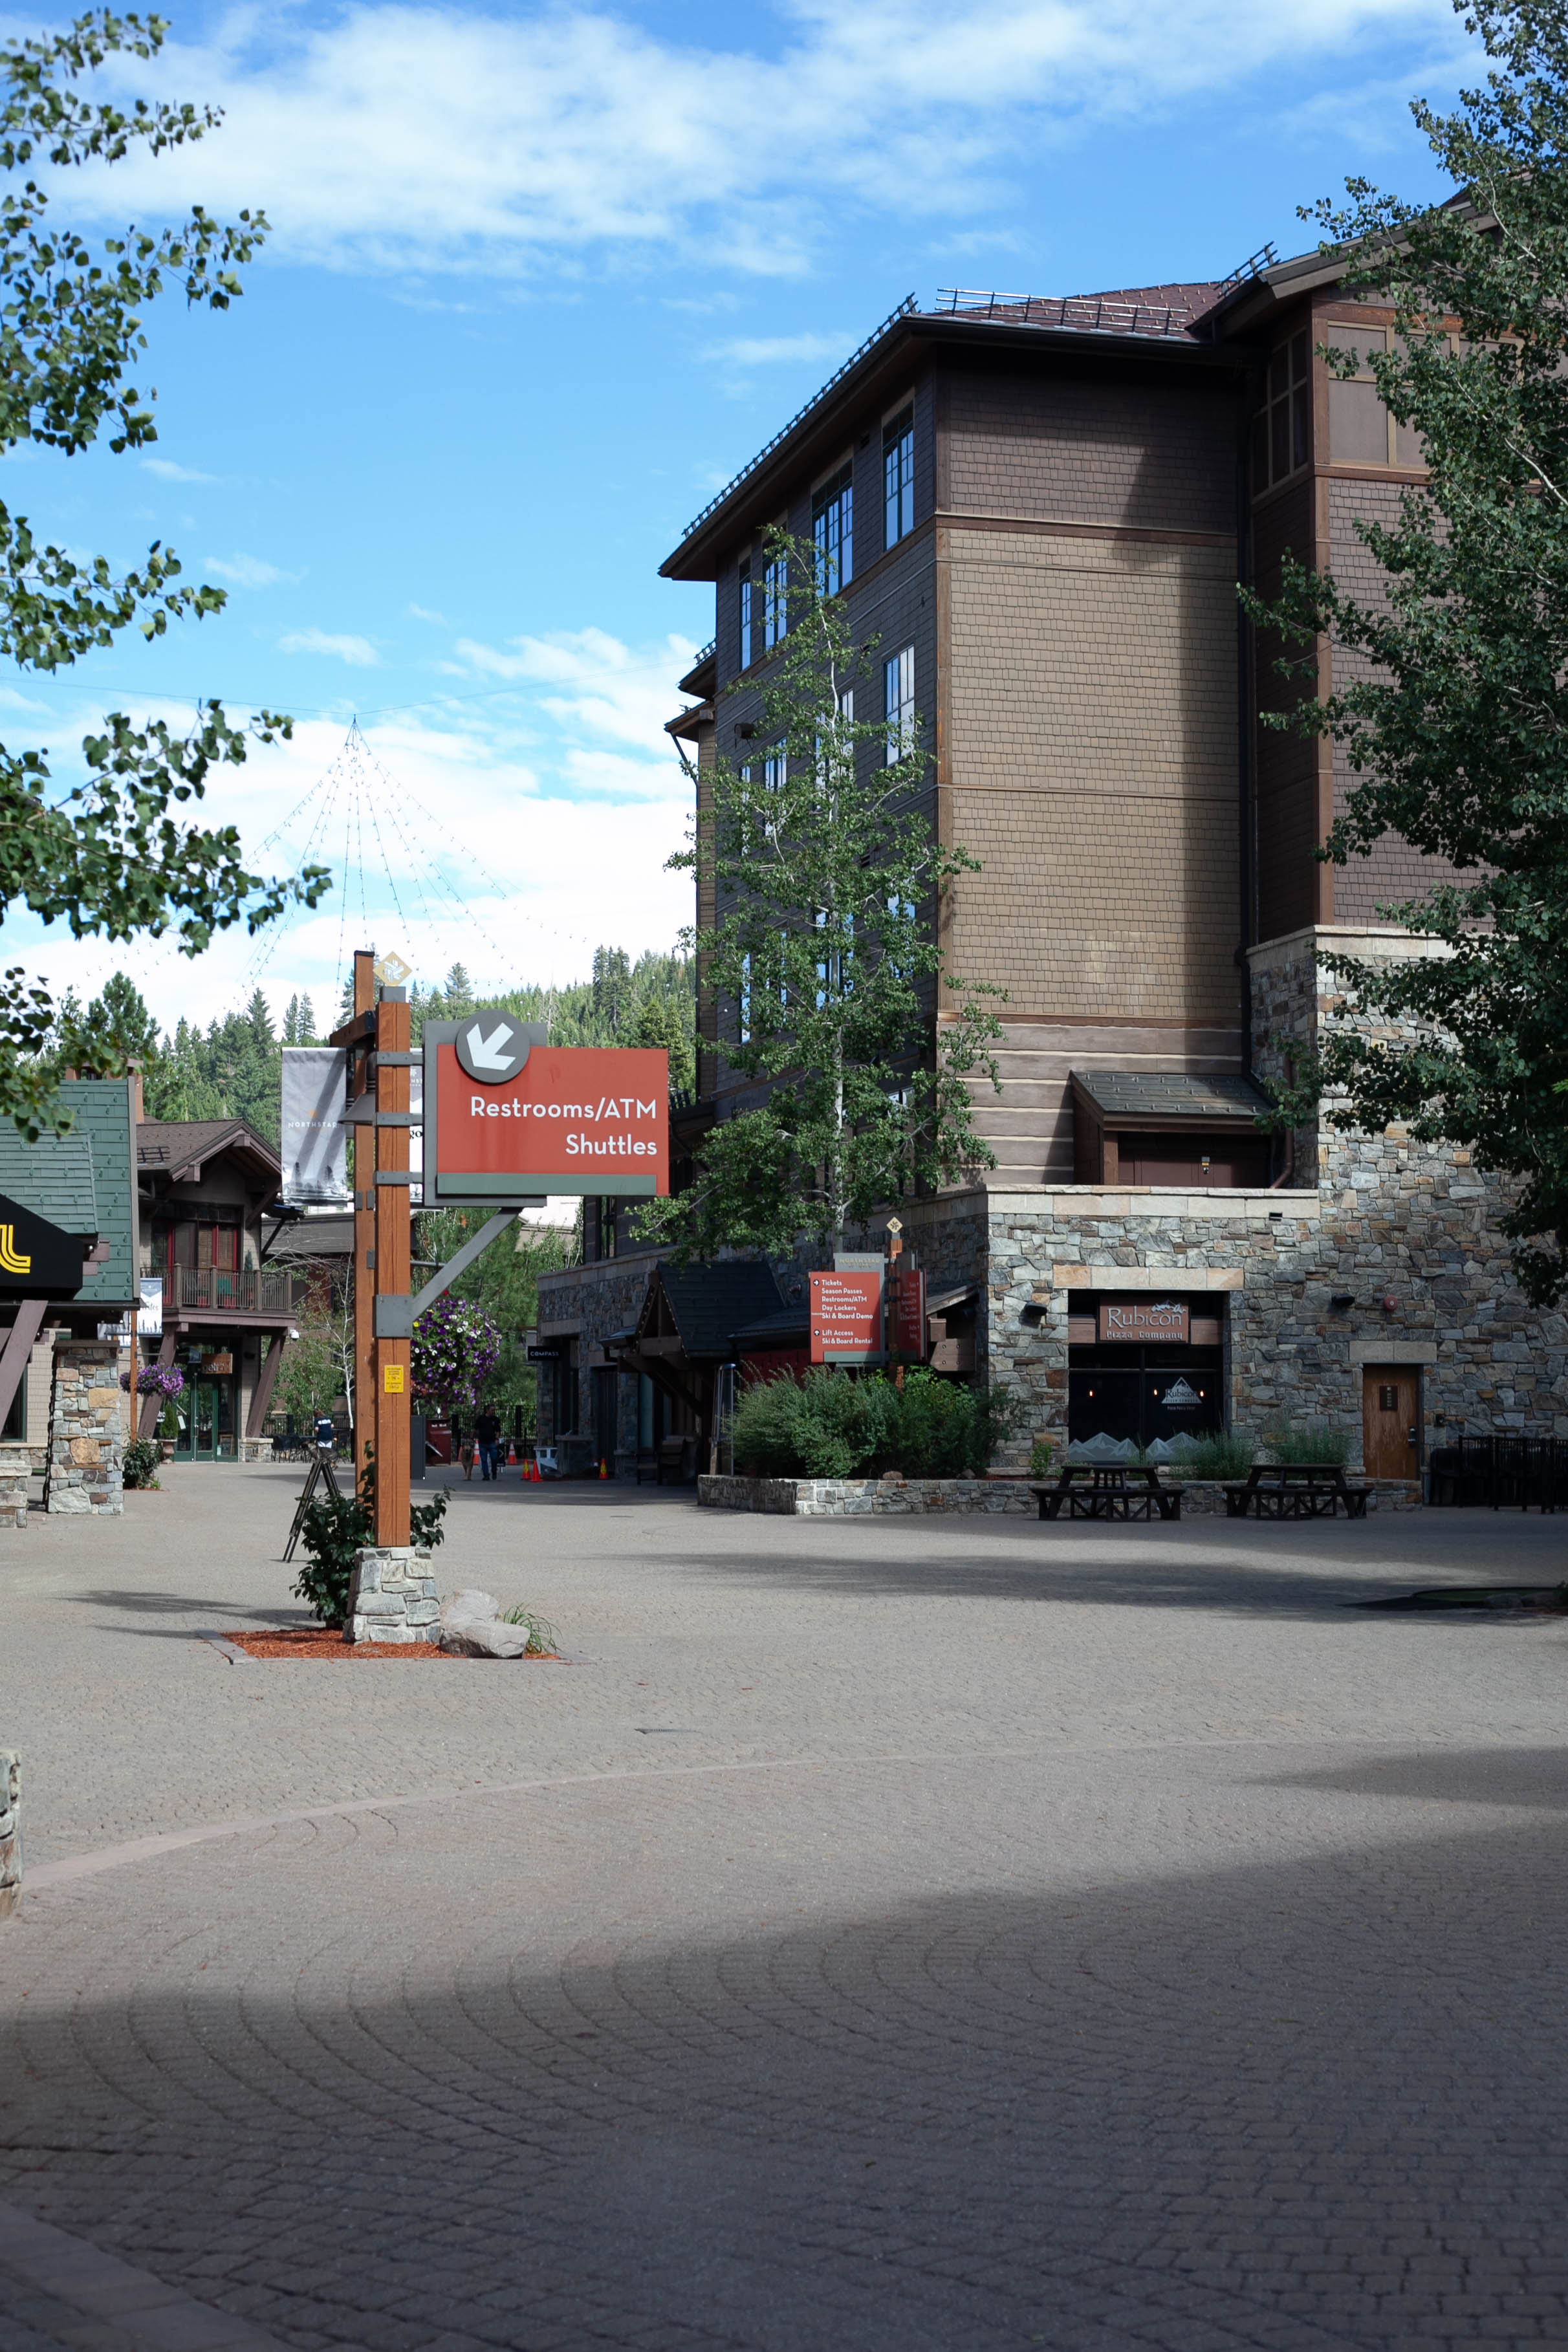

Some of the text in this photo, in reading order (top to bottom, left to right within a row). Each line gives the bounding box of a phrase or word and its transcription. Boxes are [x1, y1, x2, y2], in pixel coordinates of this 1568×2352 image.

[471, 1096, 657, 1122] Restrooms/ATM
[565, 1134, 657, 1155] Shuttles
[1107, 1305, 1182, 1329] Rubicon
[1107, 1331, 1183, 1340] Pizza Company
[1166, 1388, 1197, 1398] Rubicon
